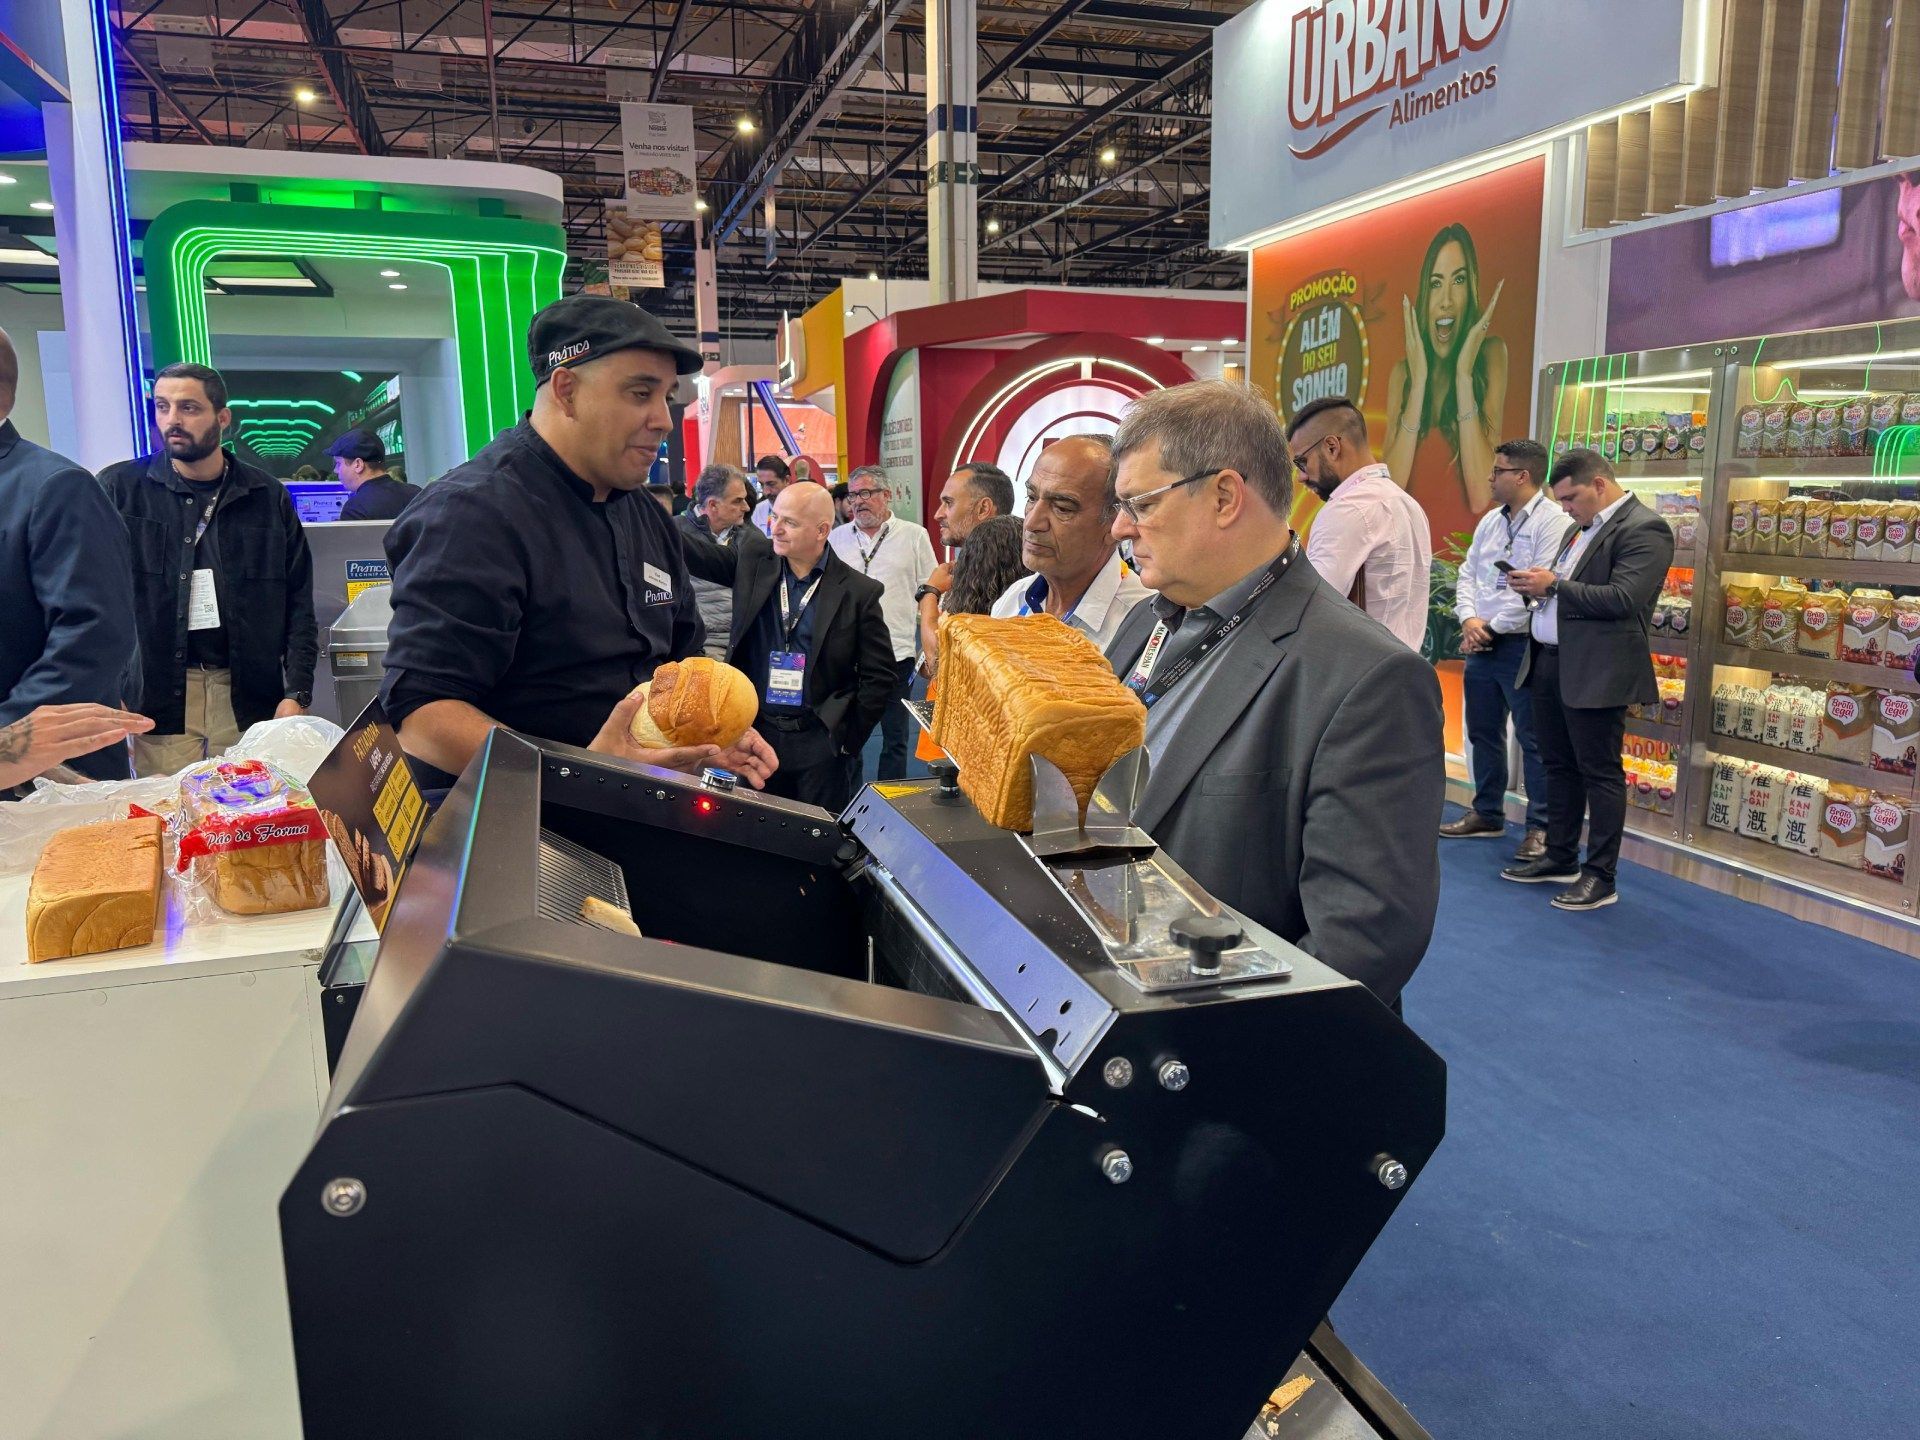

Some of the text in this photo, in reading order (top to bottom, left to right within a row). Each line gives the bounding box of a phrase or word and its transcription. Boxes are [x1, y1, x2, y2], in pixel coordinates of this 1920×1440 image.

[1389, 64, 1497, 129] Alimentos
[629, 142, 651, 151] Venha
[667, 143, 689, 152] visitar!
[1290, 271, 1357, 310] PROMOÇÃO
[1300, 306, 1342, 353] ALÉM
[1302, 342, 1337, 373] DO SEU
[1292, 362, 1348, 412] SONHO
[1765, 612, 1782, 621] Broto
[1807, 610, 1825, 618] Broto
[1217, 614, 1240, 638] 2025
[1765, 618, 1782, 628] Legal
[1807, 616, 1825, 625] Legal
[1832, 698, 1853, 710] Broto
[1885, 698, 1908, 710] Broto
[1831, 707, 1854, 718] Legal
[1885, 707, 1909, 718] Legal
[1714, 784, 1732, 793] KAN
[1713, 790, 1728, 800] GAI
[1750, 790, 1770, 799] KAN
[1749, 798, 1766, 807] GAI
[1790, 800, 1811, 810] KAN
[1789, 808, 1807, 818] GAI
[1829, 806, 1852, 819] Broto
[1873, 806, 1897, 819] Broto
[1829, 814, 1852, 827] Legal
[1874, 815, 1897, 828] Legal
[206, 823, 309, 849] Pão de Forma
